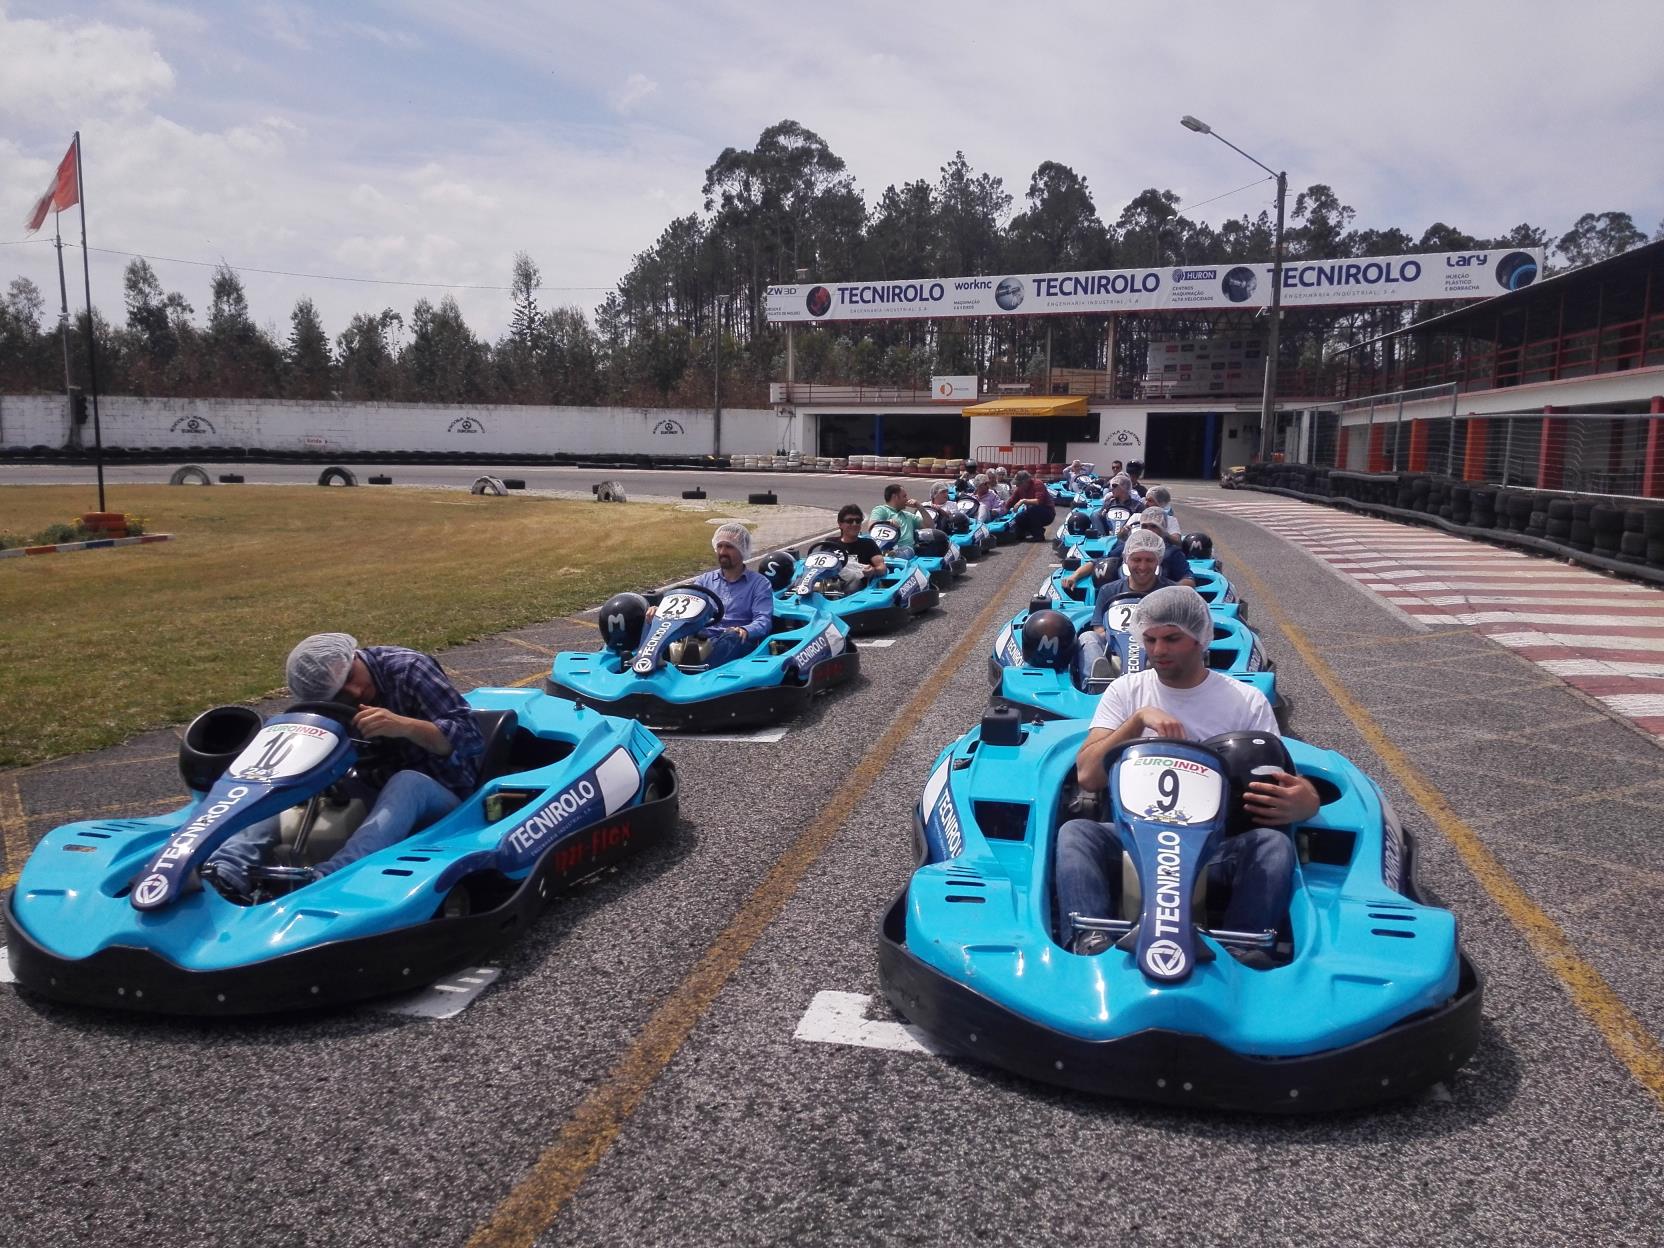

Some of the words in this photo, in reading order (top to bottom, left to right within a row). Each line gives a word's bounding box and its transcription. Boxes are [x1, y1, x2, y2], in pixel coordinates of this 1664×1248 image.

[954, 279, 992, 291] worknc
[1032, 272, 1161, 298] TECNIROLO
[1186, 271, 1214, 280] HURON
[1267, 260, 1421, 289] TECNIROLO
[837, 282, 945, 305] TECNIROLO
[1114, 511, 1123, 519] 13
[877, 528, 891, 538] 15
[765, 561, 780, 577] S
[814, 556, 828, 567] 16
[662, 597, 691, 616] 23
[607, 613, 626, 633] M
[1037, 634, 1060, 656] M
[254, 731, 295, 771] 10
[1133, 758, 1209, 775] EUROINDY
[1156, 768, 1180, 814] 9
[507, 780, 595, 854] TECNIROLO
[937, 787, 962, 859] TECNIROL
[152, 786, 249, 873] TECNIROLO
[1155, 830, 1181, 937] TECNIROLO
